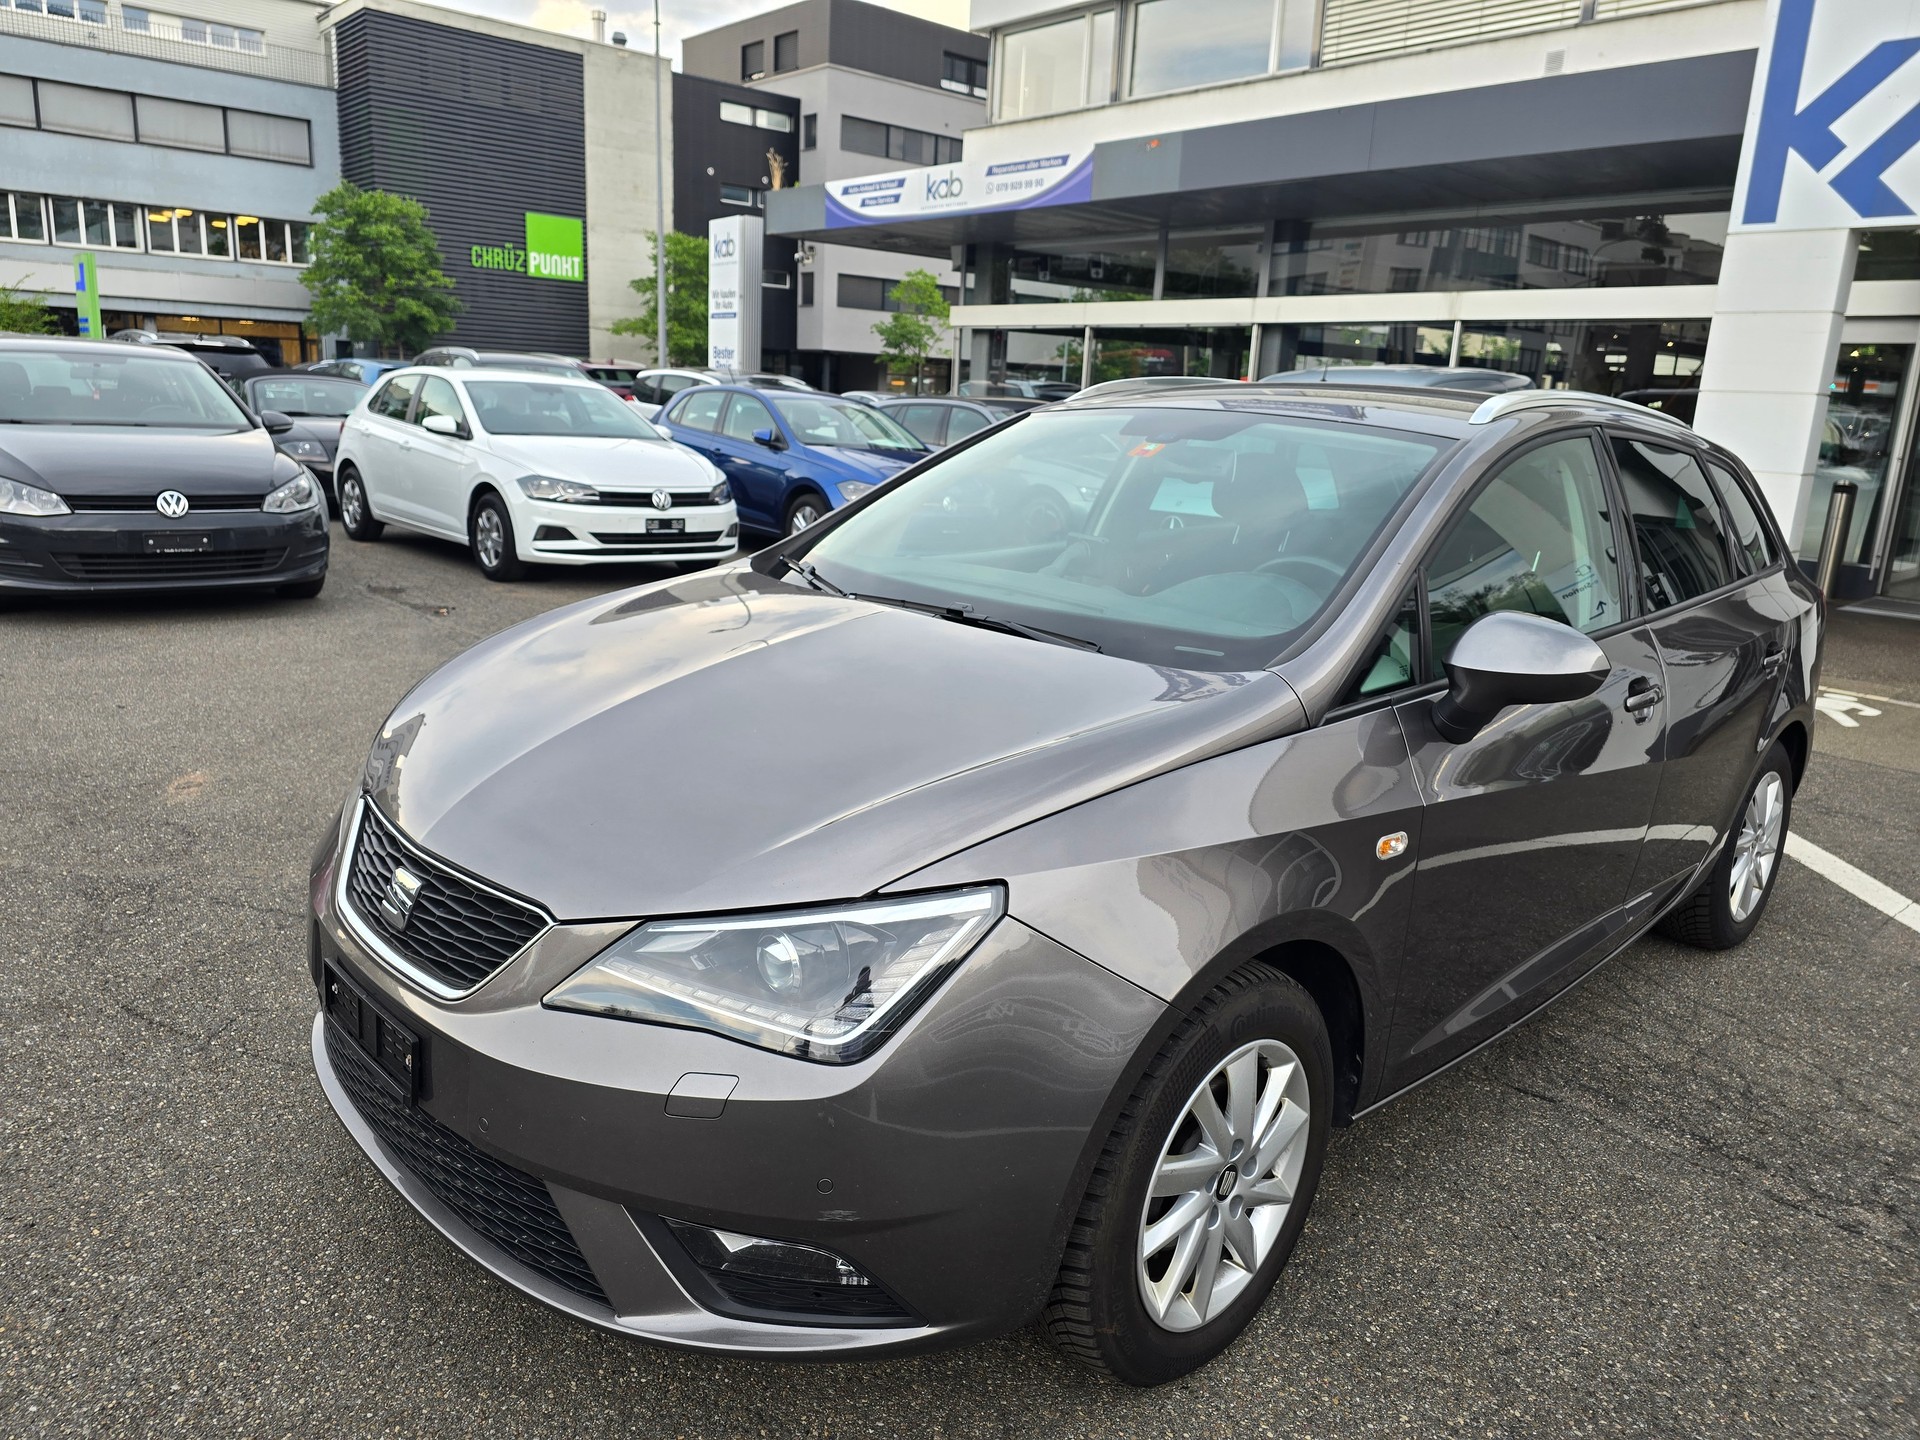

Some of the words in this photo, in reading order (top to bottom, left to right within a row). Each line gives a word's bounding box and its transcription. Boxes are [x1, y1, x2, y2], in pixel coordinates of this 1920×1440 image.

[926, 170, 963, 201] kab
[471, 242, 525, 272] CHRÜZ
[529, 251, 580, 278] PUNKT
[714, 232, 736, 259] kab
[713, 346, 735, 359] Bester
